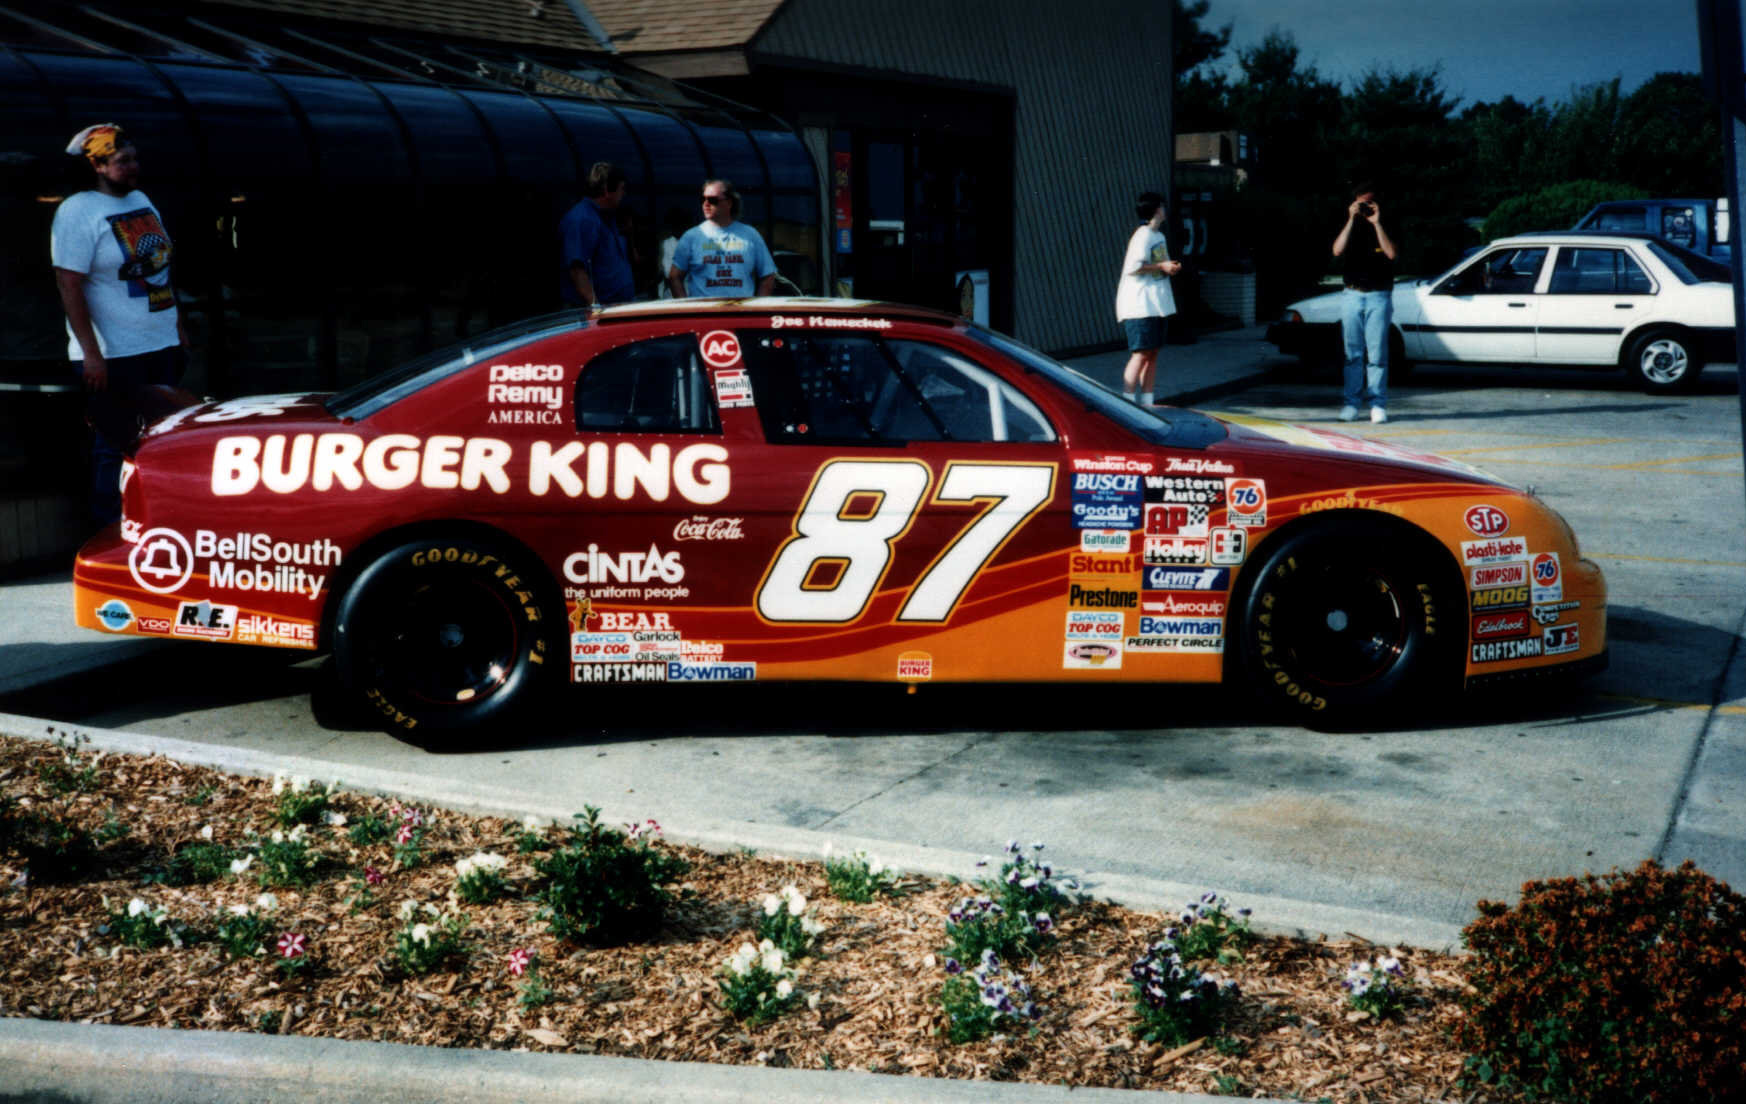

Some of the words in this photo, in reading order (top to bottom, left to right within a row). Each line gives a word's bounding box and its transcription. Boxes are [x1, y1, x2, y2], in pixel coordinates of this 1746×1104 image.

[708, 341, 736, 357] AC
[490, 364, 564, 382] Delco
[488, 384, 563, 410] Remy
[488, 411, 563, 425] AMERICA
[211, 432, 513, 497] BURGER
[529, 441, 731, 505] KING
[1074, 459, 1125, 471] Winston
[1127, 460, 1153, 473] Cup
[1075, 474, 1139, 491] BUSCH
[1145, 476, 1224, 490] Western
[1164, 490, 1207, 502] Auto
[1234, 488, 1258, 504] 76
[1074, 503, 1140, 518] Goody's
[1470, 508, 1504, 531] STP
[673, 518, 744, 541] Coca-Cola
[1147, 507, 1189, 535] AP
[753, 456, 1059, 627] 87
[1084, 532, 1127, 545] Gatorade
[195, 529, 342, 567] BellSouth
[1146, 539, 1207, 564] Holley
[1467, 541, 1523, 560] plasti-kote
[1072, 556, 1131, 574] Stant
[1536, 560, 1555, 580] 76
[209, 562, 325, 600] Mobility
[1475, 566, 1523, 586] SIMPSON
[565, 588, 586, 598] the
[590, 587, 641, 598] uniform
[644, 586, 689, 600] people
[1069, 584, 1138, 608] Prestone
[1473, 587, 1529, 607] MOOG
[1162, 595, 1224, 614] Aeroquip
[138, 619, 170, 629] VDO
[238, 616, 314, 640] sikkens
[600, 613, 674, 631] BEAR
[1069, 623, 1094, 633] TOP
[1096, 623, 1121, 633] COG
[1140, 617, 1221, 635] Bowman
[633, 631, 681, 642] Garlock
[1128, 638, 1179, 647] PERFECT
[1181, 639, 1223, 648] CIRCLE
[1546, 625, 1579, 648] JE
[574, 644, 602, 655] TOP
[603, 644, 630, 655] COG
[635, 652, 650, 661] Oil
[651, 652, 680, 662] Seals
[1472, 638, 1542, 662] CRAFTSMAN
[574, 664, 666, 682] CRAFTSMAN
[667, 663, 755, 681] Bowman
[899, 666, 930, 676] KING
